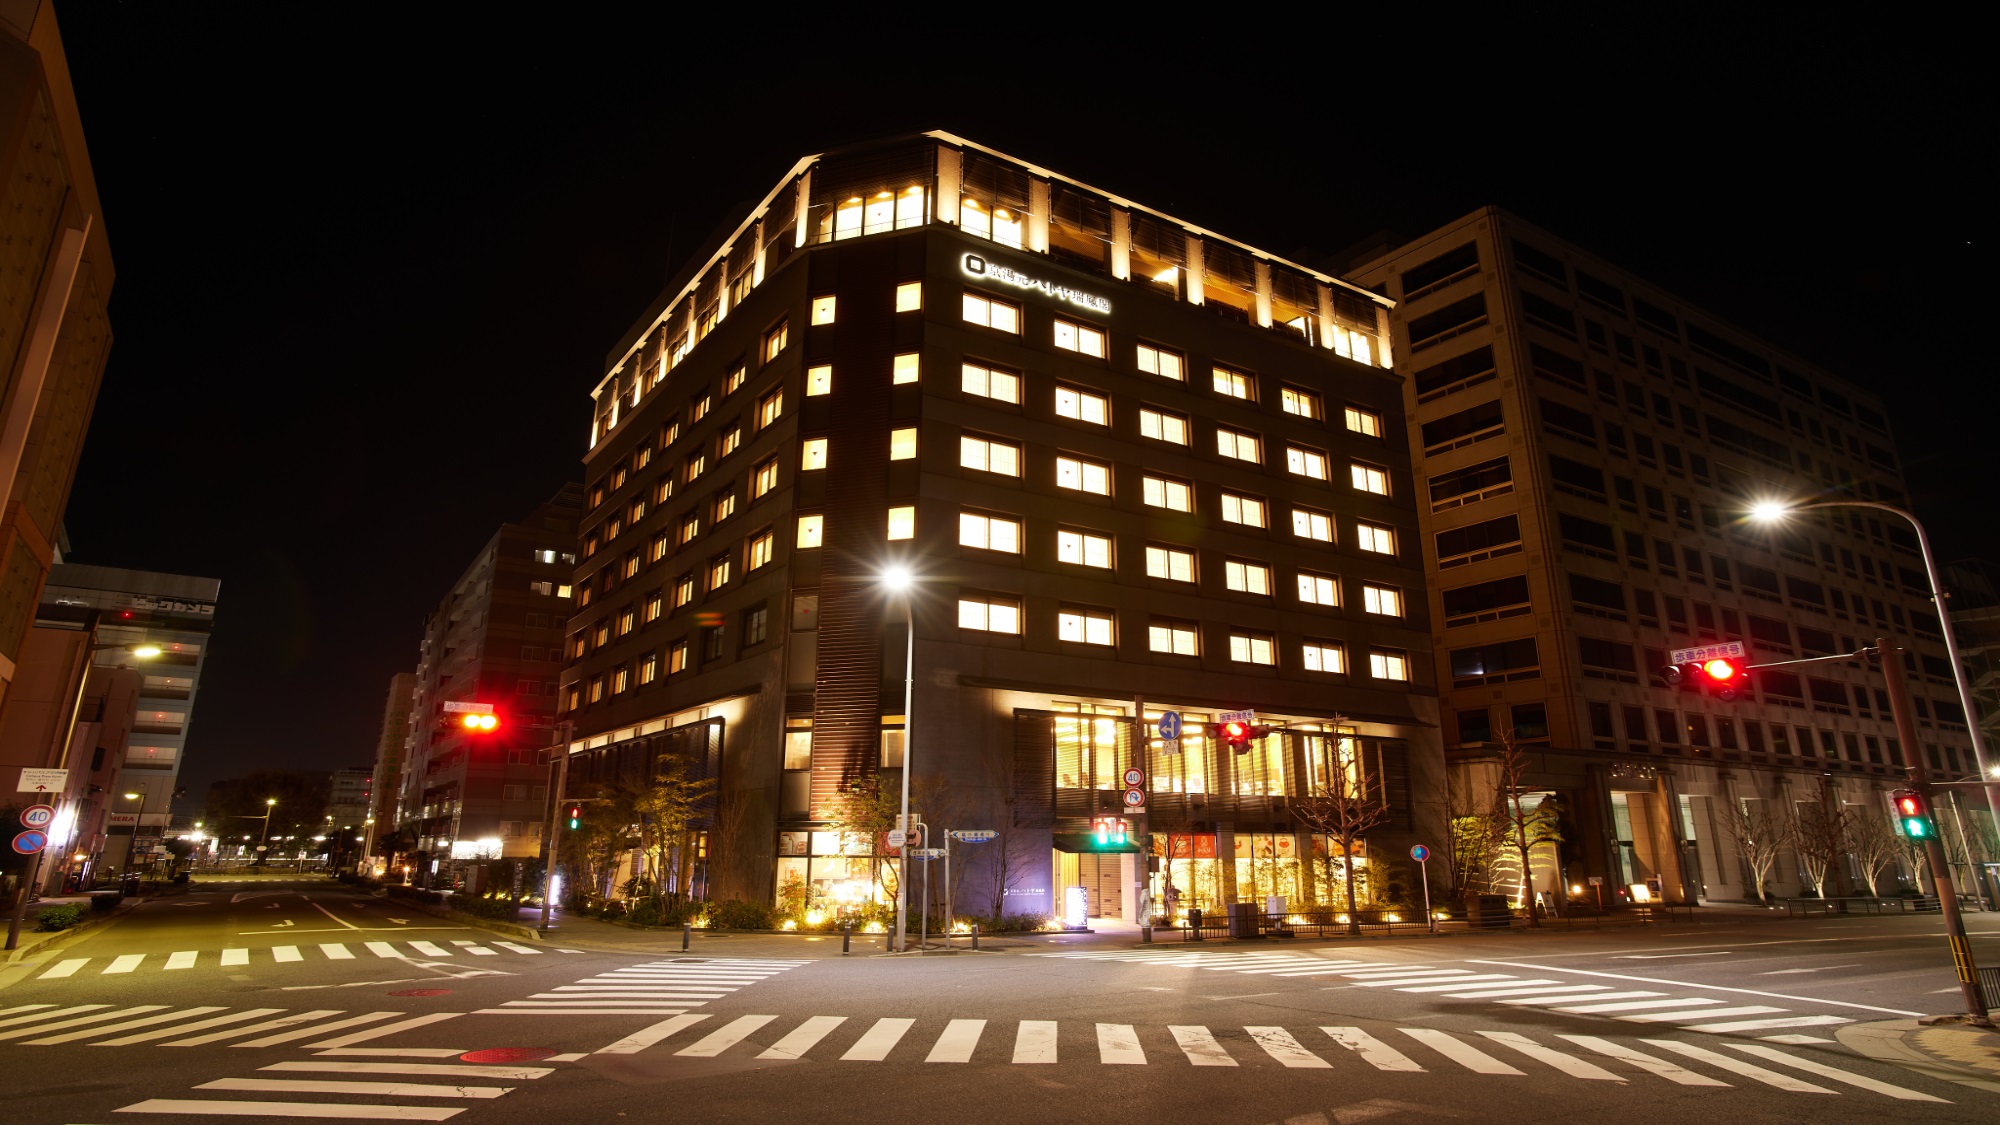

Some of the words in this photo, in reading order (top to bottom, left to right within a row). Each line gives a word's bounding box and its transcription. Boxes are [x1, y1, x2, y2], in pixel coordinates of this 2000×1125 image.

[1675, 644, 1740, 663] 歩車分離信号
[1128, 773, 1139, 782] 40
[28, 811, 48, 822] 40
